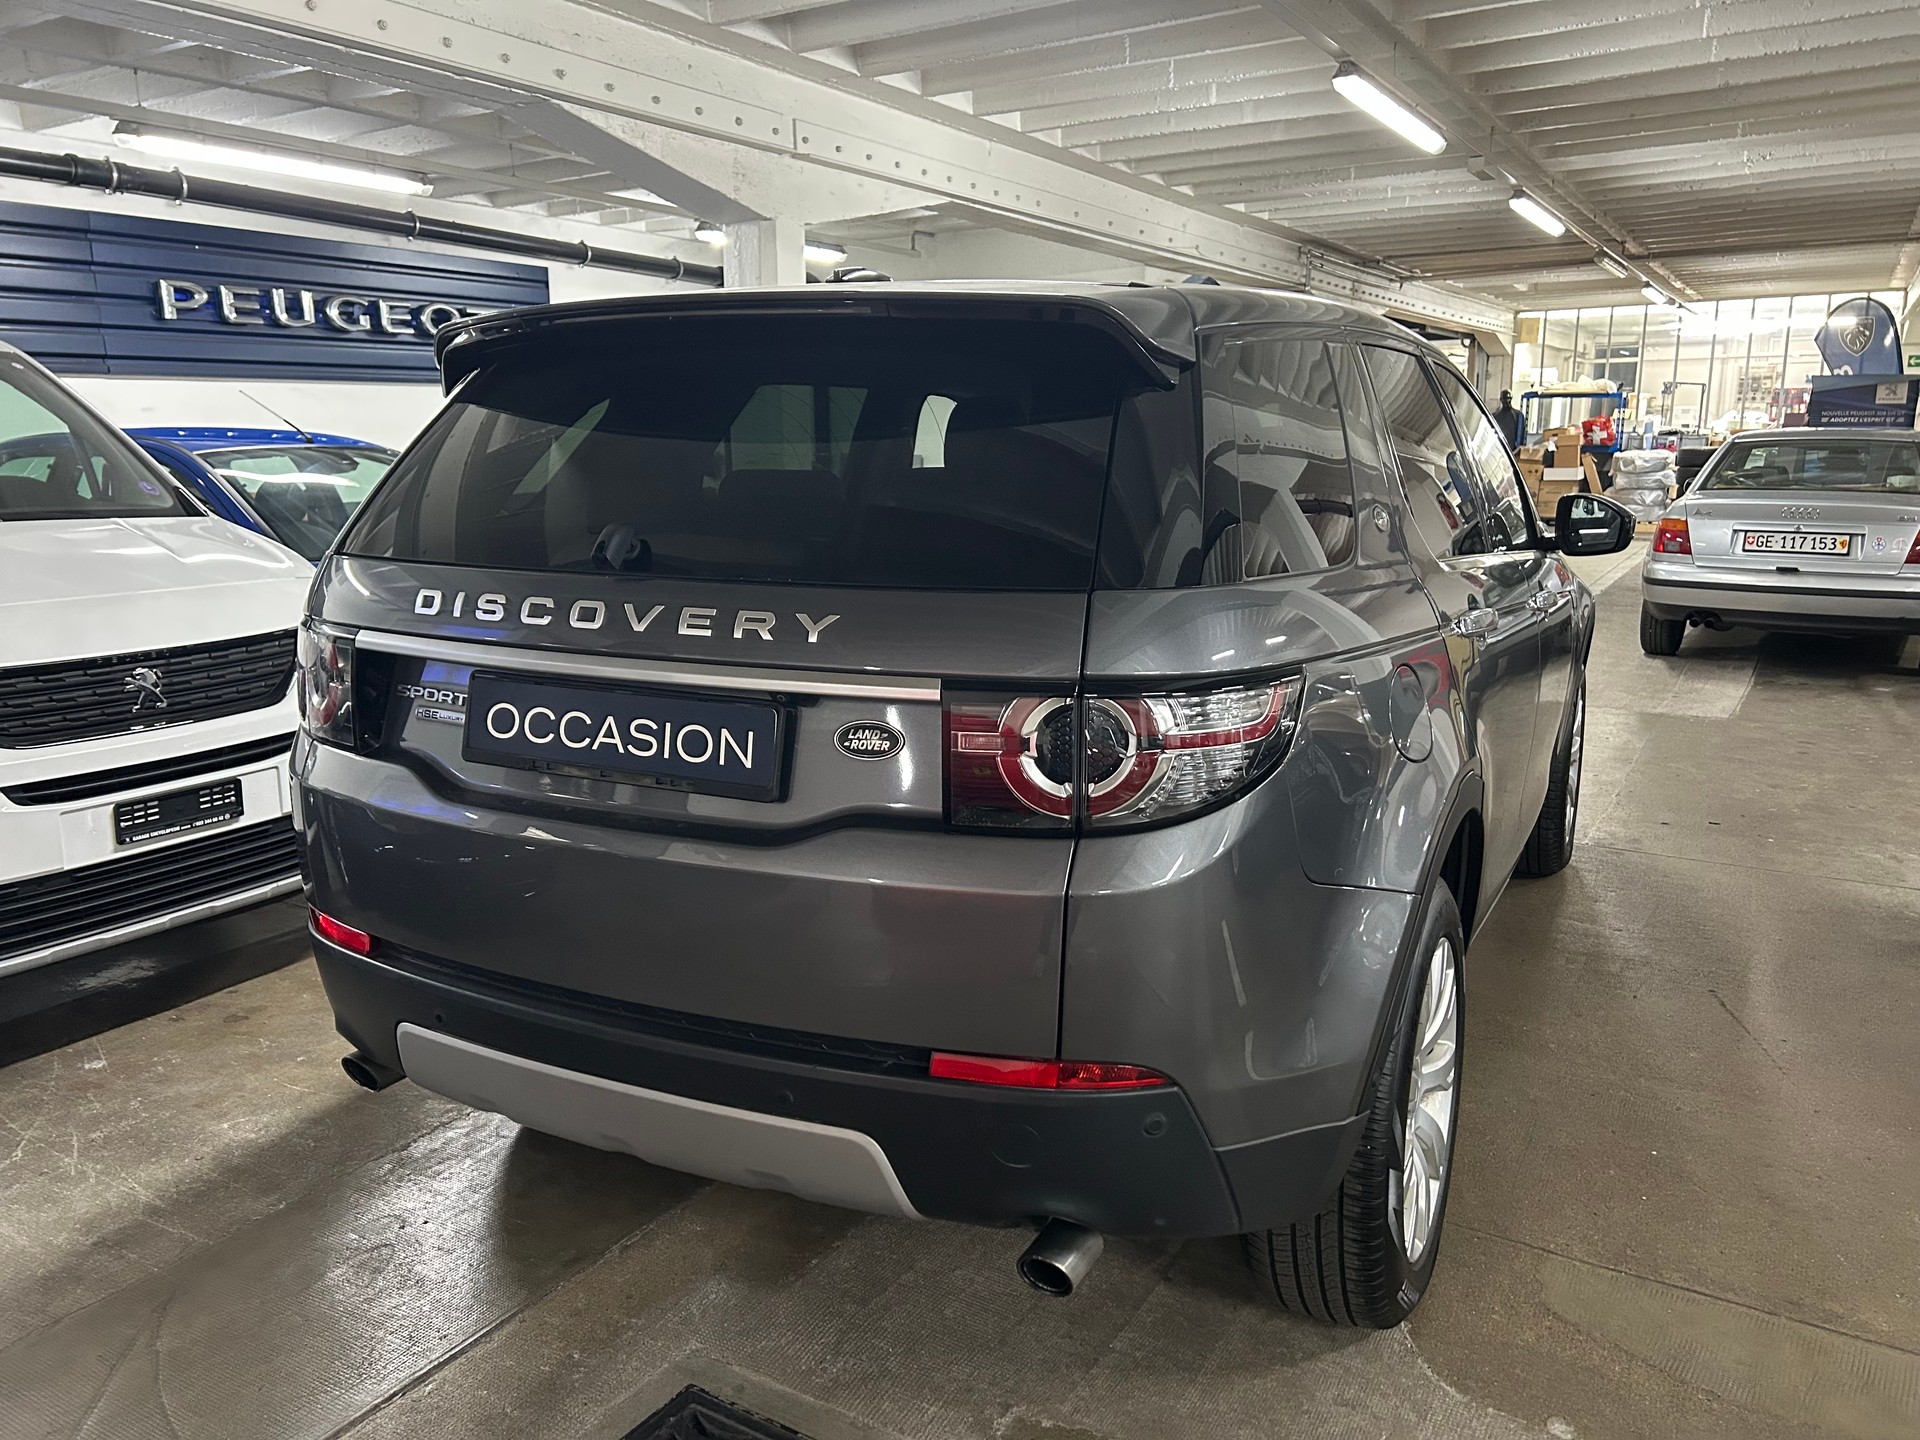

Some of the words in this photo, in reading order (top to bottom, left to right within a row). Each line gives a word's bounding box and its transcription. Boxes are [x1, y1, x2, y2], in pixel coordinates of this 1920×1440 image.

[154, 278, 496, 337] PEUGEO
[413, 588, 841, 643] DISCOVERY
[396, 684, 468, 706] SPORT
[416, 708, 439, 720] HSE
[439, 713, 464, 722] LUXURY
[486, 702, 755, 769] OCCASION
[847, 728, 881, 740] LAND
[849, 739, 891, 752] ROVER
